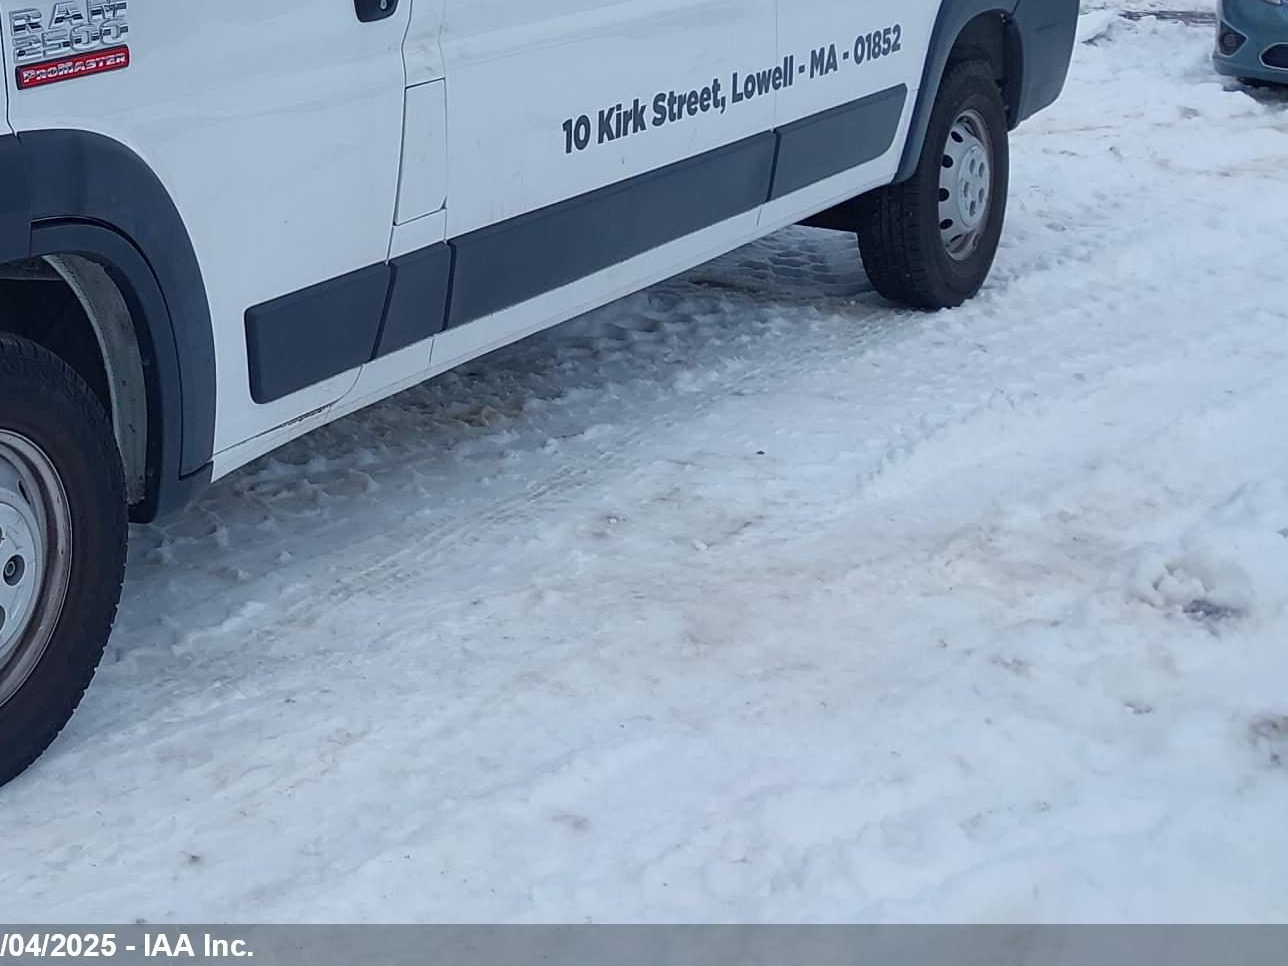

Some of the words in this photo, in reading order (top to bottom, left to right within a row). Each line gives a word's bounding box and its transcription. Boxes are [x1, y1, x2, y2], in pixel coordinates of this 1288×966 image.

[562, 114, 591, 154] 10
[597, 99, 646, 144] Kirk
[651, 78, 726, 126] Street,
[731, 55, 794, 104] Lowell
[809, 44, 838, 79] MA
[853, 24, 902, 65] 01852
